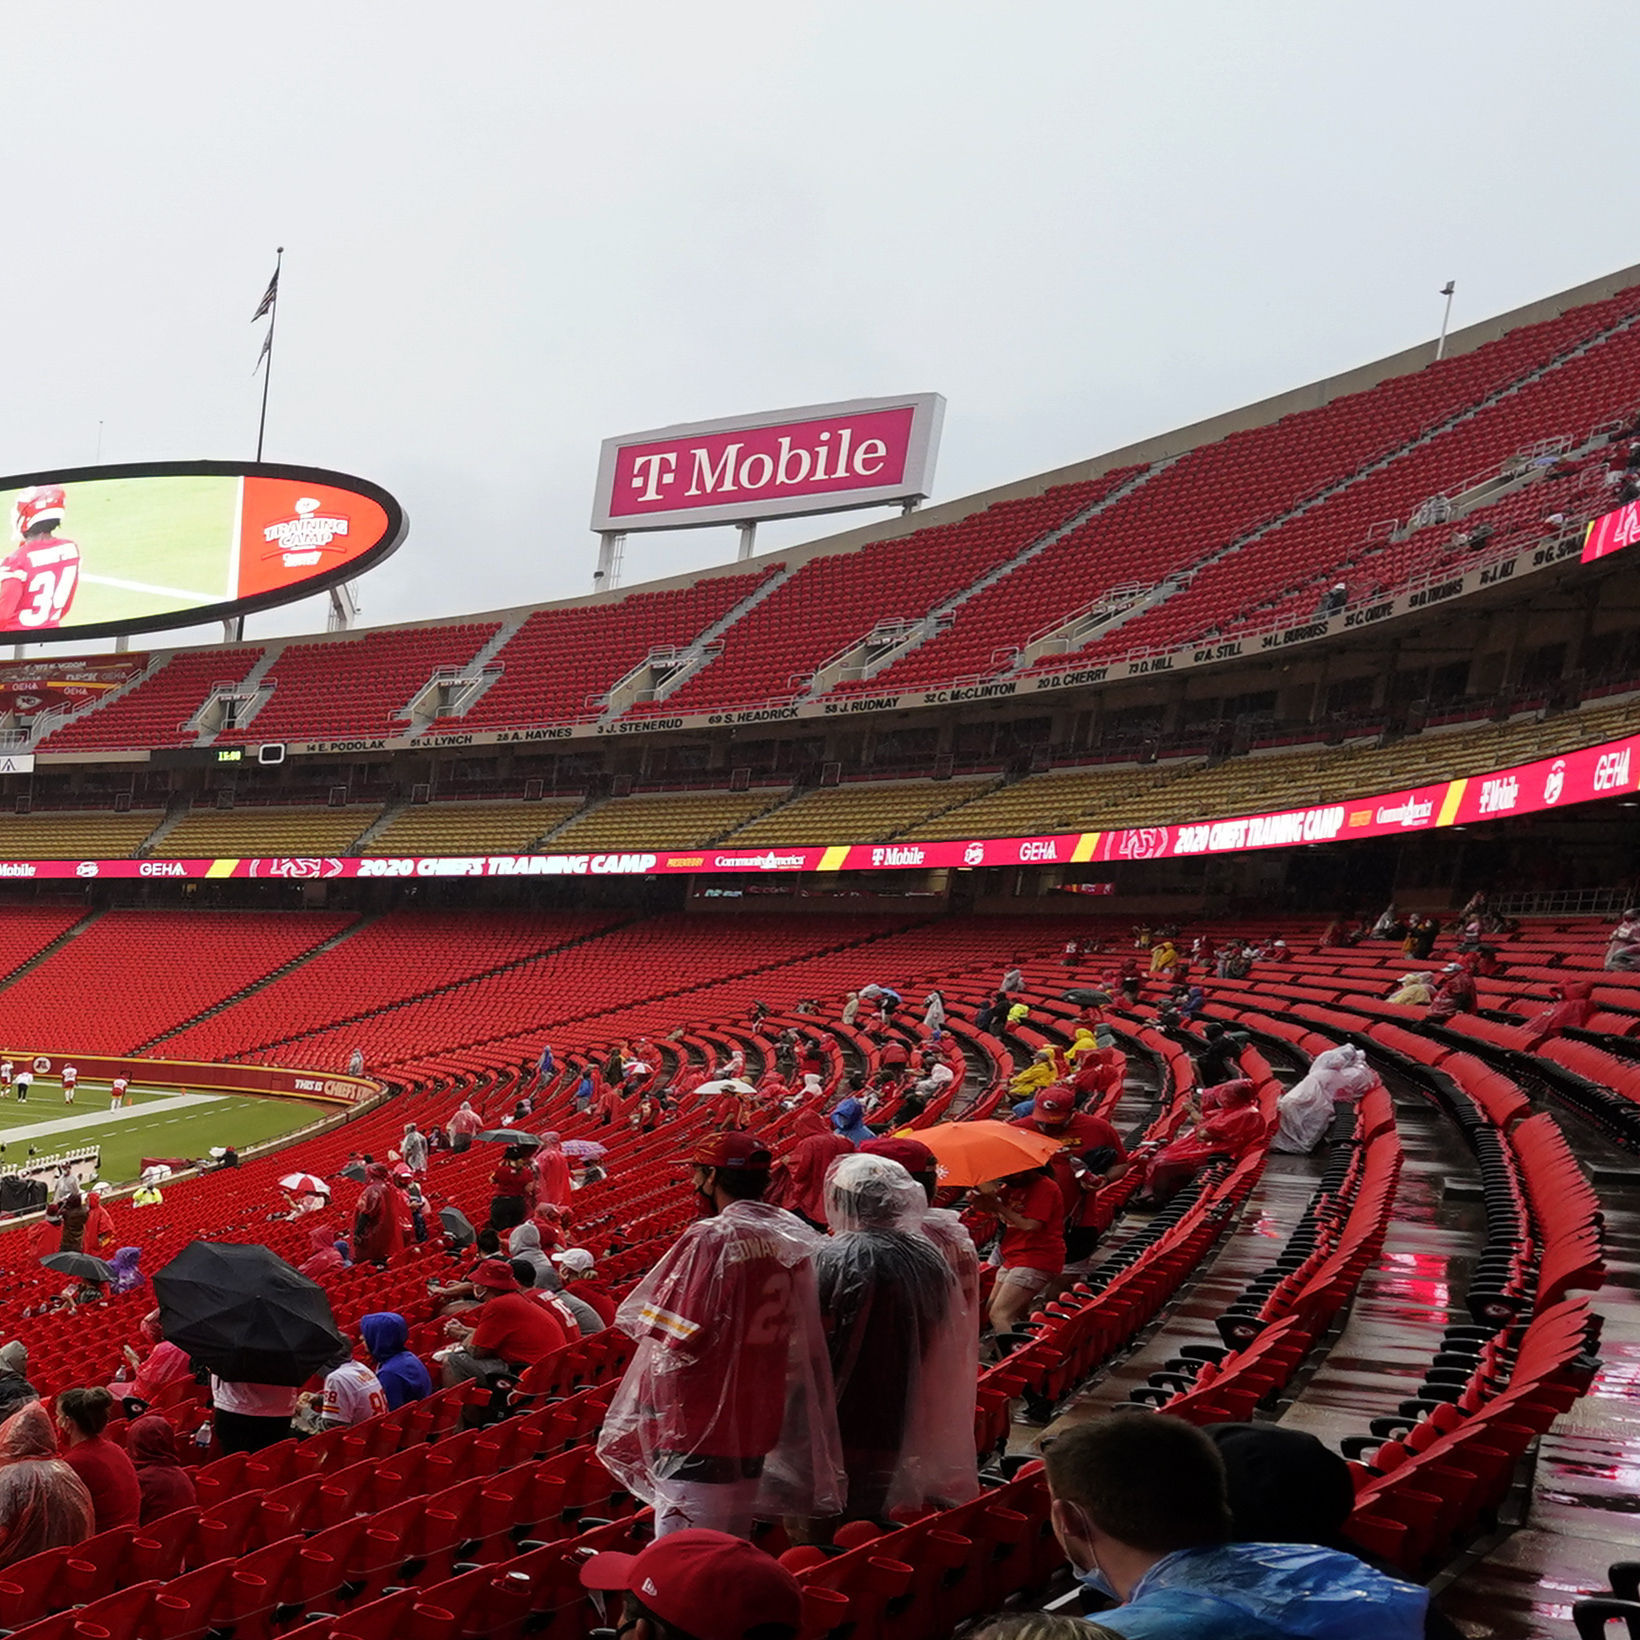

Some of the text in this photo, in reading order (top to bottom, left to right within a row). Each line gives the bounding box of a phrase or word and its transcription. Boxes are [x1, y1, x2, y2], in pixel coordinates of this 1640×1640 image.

[685, 428, 886, 496] Mobile
[264, 518, 348, 542] TRAINING
[279, 532, 334, 548] CAMP
[1499, 559, 1517, 580] ALT
[1217, 642, 1243, 658] STILL
[1129, 657, 1173, 674] 73 D. HILL
[1038, 668, 1108, 689] 20 D. CHERRY
[64, 687, 88, 695] GEHA
[938, 692, 948, 703] C.
[950, 682, 1016, 702] McCLINTON
[839, 697, 899, 713] J. RUDNAY
[708, 707, 798, 725] 69 S. HEADRICK
[512, 728, 572, 741] A. HAYNES
[608, 719, 683, 734] J. STENERUD
[319, 740, 385, 752] E. PODOLAK
[422, 738, 432, 747] J.
[434, 735, 472, 746] LYNCH
[1594, 748, 1630, 792] GEHA
[1173, 806, 1345, 854] 2020 CHIEFS TRAINING CAMP
[715, 851, 805, 868] CommunityAmerica
[885, 847, 923, 865] Mobile
[1020, 841, 1057, 861] GEHA
[140, 863, 187, 876] GEHA
[357, 854, 656, 877] 2020 CHIEFS TRAINING CAMP
[295, 1079, 314, 1090] THIS
[314, 1081, 323, 1091] IS
[324, 1080, 357, 1099] CHIEFS
